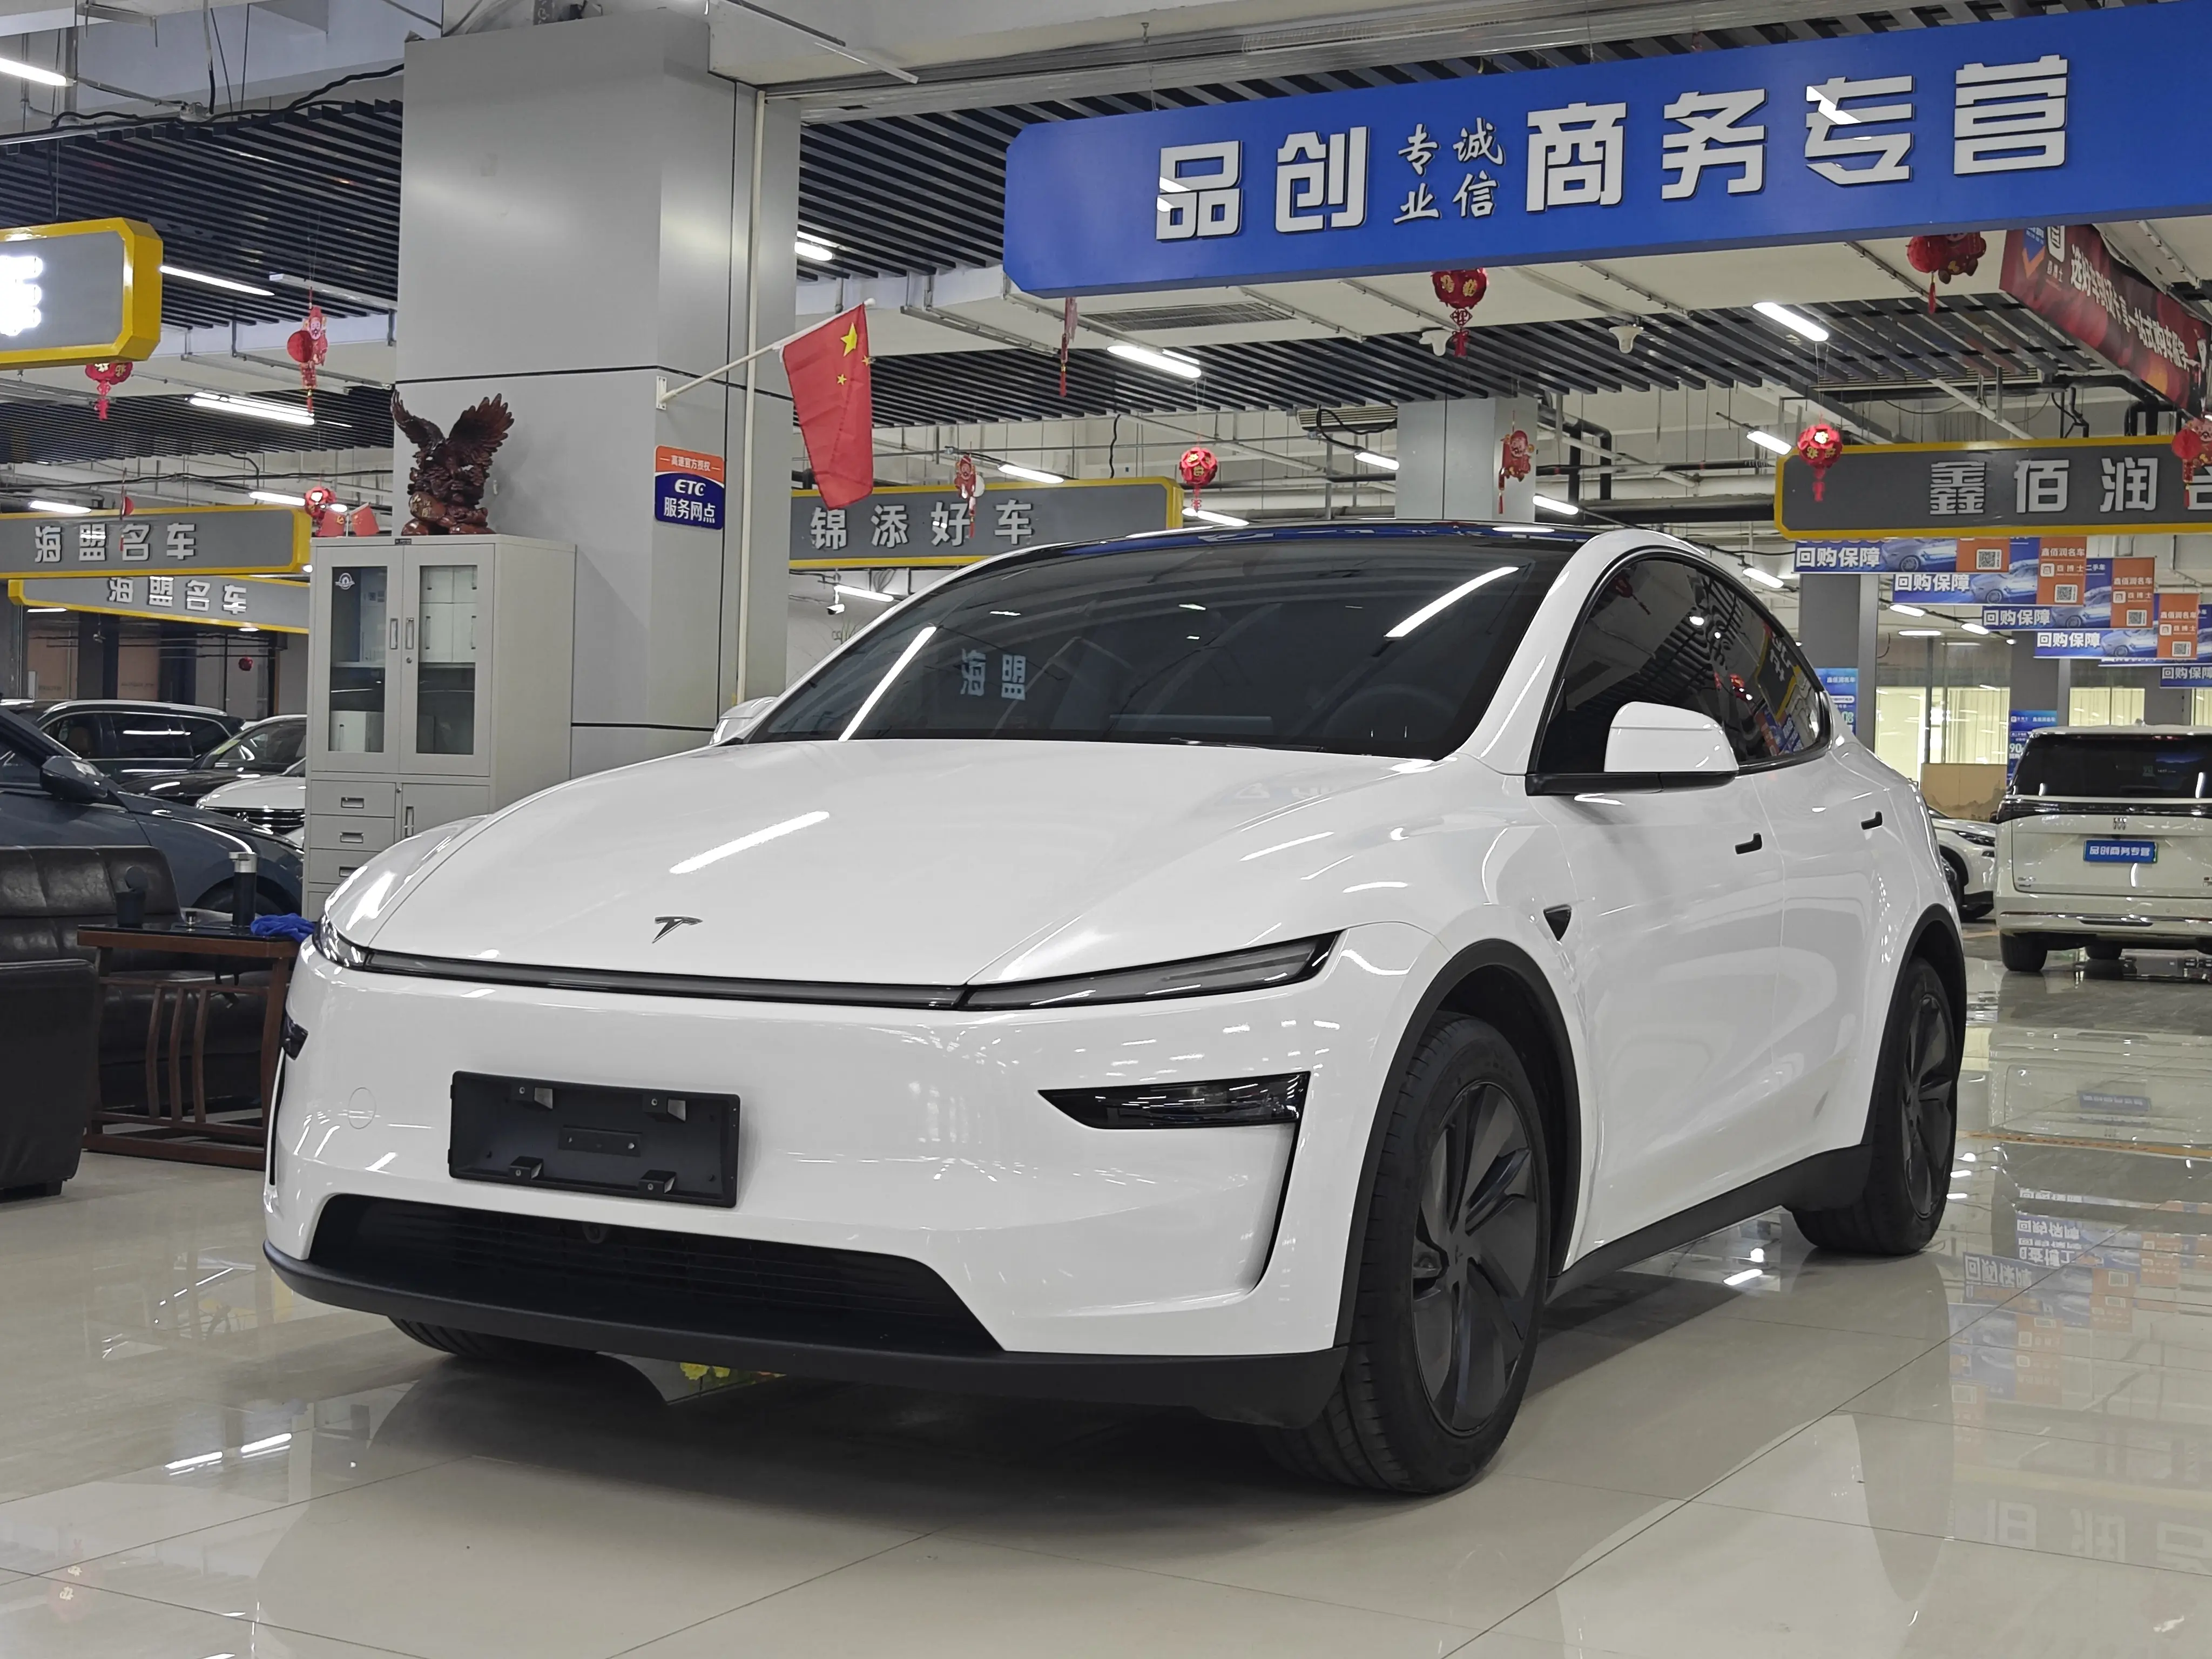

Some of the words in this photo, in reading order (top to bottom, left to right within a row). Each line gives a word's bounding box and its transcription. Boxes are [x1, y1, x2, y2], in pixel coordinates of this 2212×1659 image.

[1526, 55, 2069, 213] 商务专营
[1156, 126, 1371, 241] 品创
[671, 455, 711, 471] 高速官方授权
[675, 478, 706, 496] ETC
[664, 496, 716, 524] 服务网点
[810, 500, 1034, 550] 锦添好车
[35, 522, 197, 563] 海盟名车
[1795, 547, 1880, 568] 回购保障
[109, 576, 247, 615] 海盟名车
[1894, 574, 1970, 593] 回购保障
[1983, 609, 2051, 626] 回购保障
[2036, 631, 2101, 648] 回购保障
